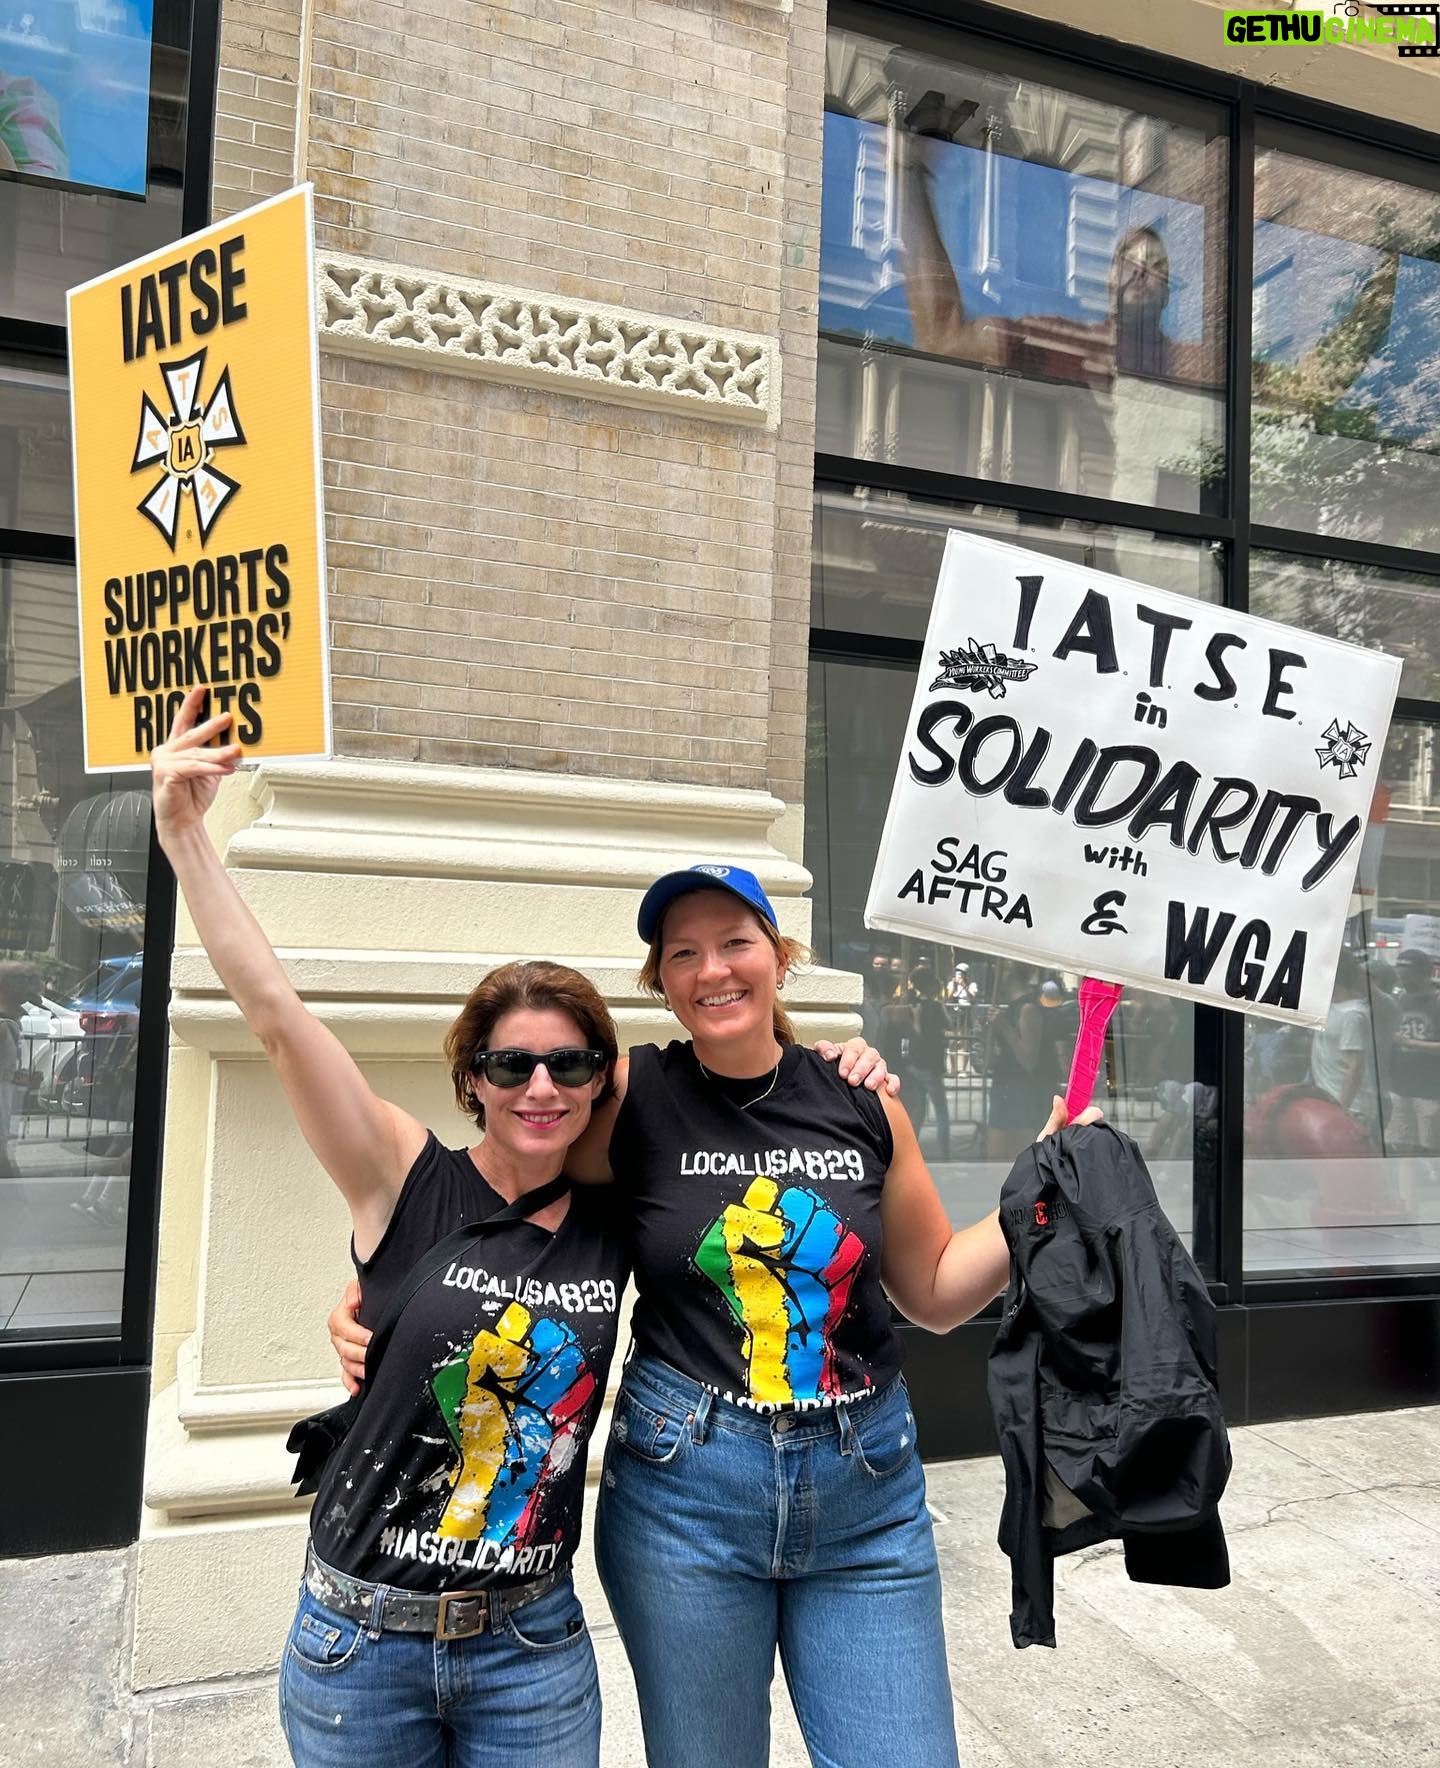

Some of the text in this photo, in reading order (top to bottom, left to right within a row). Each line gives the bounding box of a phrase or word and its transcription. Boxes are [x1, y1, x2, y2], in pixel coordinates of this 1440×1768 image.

[121, 234, 247, 362] IATSE
[178, 437, 194, 462] IA
[104, 543, 290, 635] SUPPORTS
[104, 611, 290, 695] WORKERS'
[993, 667, 1026, 678] COMMITTEE
[1134, 692, 1167, 728] in
[909, 700, 1361, 892] SOLIDARITY
[931, 837, 1007, 883] SAG
[1084, 843, 1148, 877] with
[898, 869, 1033, 928] AFTRA
[1164, 900, 1307, 1009] WGA
